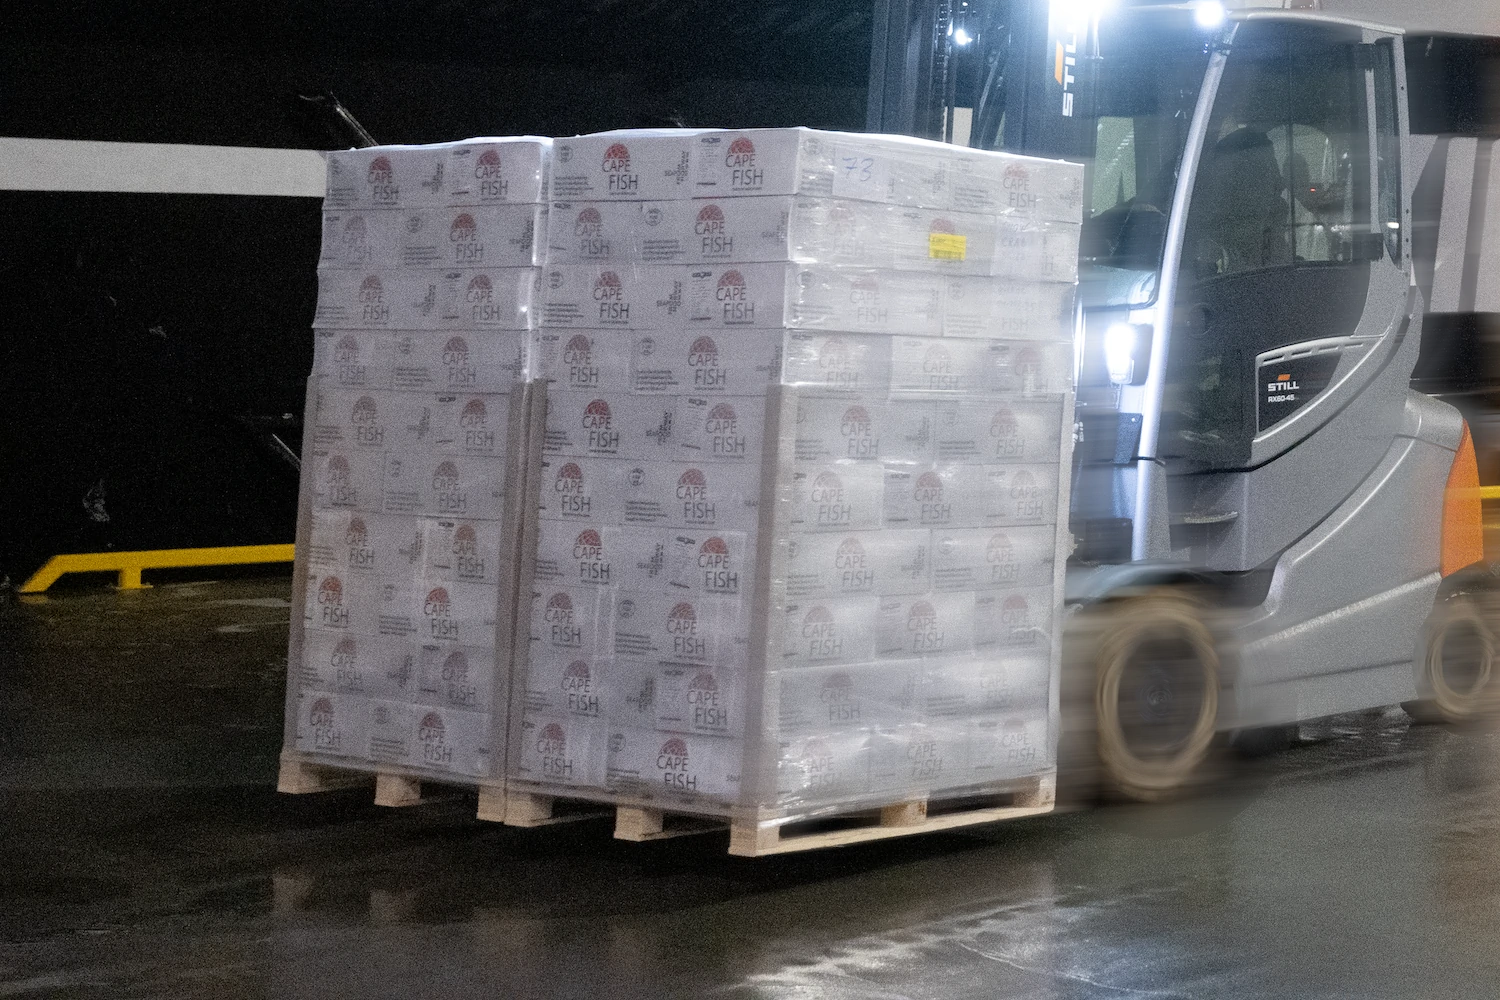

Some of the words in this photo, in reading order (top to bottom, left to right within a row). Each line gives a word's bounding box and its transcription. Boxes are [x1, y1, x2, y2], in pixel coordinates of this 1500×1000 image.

[1062, 22, 1077, 117] STIL
[602, 160, 631, 173] CAPE
[725, 154, 755, 167] CAPE
[475, 166, 501, 178] CAPE
[842, 157, 874, 182] 73
[368, 171, 393, 184] CAPE
[608, 175, 638, 190] FISH
[732, 170, 763, 186] FISH
[1003, 177, 1029, 191] CAPE
[372, 186, 399, 199] FISH
[481, 180, 508, 195] FISH
[1009, 193, 1036, 209] FISH
[450, 229, 477, 242] CAPE
[574, 224, 603, 237] CAPE
[695, 222, 725, 235] CAPE
[456, 244, 483, 258] FISH
[581, 240, 610, 254] FISH
[702, 237, 733, 252] FISH
[359, 291, 383, 303] CAPE
[466, 291, 492, 303] CAPE
[593, 287, 622, 300] CAPE
[716, 287, 746, 300] CAPE
[850, 291, 880, 304] CAPE
[363, 306, 389, 319] FISH
[472, 306, 499, 320] FISH
[600, 303, 630, 319] FISH
[723, 303, 754, 319] FISH
[857, 308, 888, 323] FISH
[334, 351, 359, 363] CAPE
[442, 352, 469, 365] CAPE
[564, 352, 592, 365] CAPE
[688, 353, 719, 367] CAPE
[339, 366, 366, 380] FISH
[923, 360, 951, 373] CAPE
[449, 367, 477, 382] FISH
[570, 367, 599, 383] FISH
[695, 369, 726, 385] FISH
[827, 372, 859, 388] FISH
[929, 376, 960, 390] FISH
[1267, 381, 1300, 392] STILL
[1267, 394, 1295, 403] RX60-45
[352, 411, 377, 424] CAPE
[460, 415, 488, 428] CAPE
[582, 416, 611, 429] CAPE
[357, 427, 384, 441] FISH
[706, 420, 737, 434] CAPE
[841, 423, 872, 437] CAPE
[990, 424, 1019, 437] CAPE
[466, 431, 494, 446] FISH
[589, 432, 620, 447] FISH
[713, 436, 745, 453] FISH
[848, 439, 879, 455] FISH
[996, 439, 1025, 454] FISH
[432, 479, 460, 490] CAPE
[555, 479, 584, 493] CAPE
[676, 486, 707, 500] CAPE
[811, 488, 843, 502] CAPE
[914, 487, 944, 501] CAPE
[438, 494, 466, 508] FISH
[562, 495, 591, 512] FISH
[684, 502, 715, 518] FISH
[818, 505, 851, 521] FISH
[920, 504, 951, 520] FISH
[1016, 502, 1043, 516] FISH
[346, 534, 367, 547] CAPE
[452, 541, 477, 555] CAPE
[573, 546, 602, 560] CAPE
[351, 551, 374, 564] FISH
[698, 554, 730, 569] CAPE
[835, 555, 867, 569] CAPE
[986, 550, 1015, 563] CAPE
[458, 557, 485, 573] FISH
[580, 562, 610, 579] FISH
[705, 571, 737, 588] FISH
[842, 572, 873, 587] FISH
[992, 565, 1020, 580] FISH
[318, 591, 342, 605] CAPE
[323, 607, 349, 622] FISH
[424, 603, 450, 617] CAPE
[546, 609, 573, 624] CAPE
[907, 617, 938, 631] CAPE
[1002, 611, 1030, 625] CAPE
[431, 619, 458, 634] FISH
[666, 620, 697, 635] CAPE
[802, 624, 835, 638] CAPE
[552, 626, 581, 643] FISH
[913, 633, 944, 648] FISH
[674, 637, 705, 654] FISH
[810, 640, 842, 656] FISH
[331, 654, 357, 668] CAPE
[337, 670, 362, 685] FISH
[442, 668, 468, 682] CAPE
[561, 677, 591, 692] CAPE
[449, 685, 476, 700] FISH
[686, 690, 719, 706] CAPE
[568, 694, 599, 712] FISH
[695, 708, 727, 726] FISH
[829, 704, 861, 720] FISH
[310, 713, 334, 727] CAPE
[315, 730, 341, 744] FISH
[419, 729, 445, 743] CAPE
[1002, 733, 1031, 747] CAPE
[424, 746, 452, 762] FISH
[537, 740, 566, 756] CAPE
[907, 744, 938, 760] CAPE
[657, 755, 688, 771] CAPE
[1008, 750, 1036, 763] FISH
[543, 756, 573, 774] FISH
[664, 773, 697, 790] FISH
